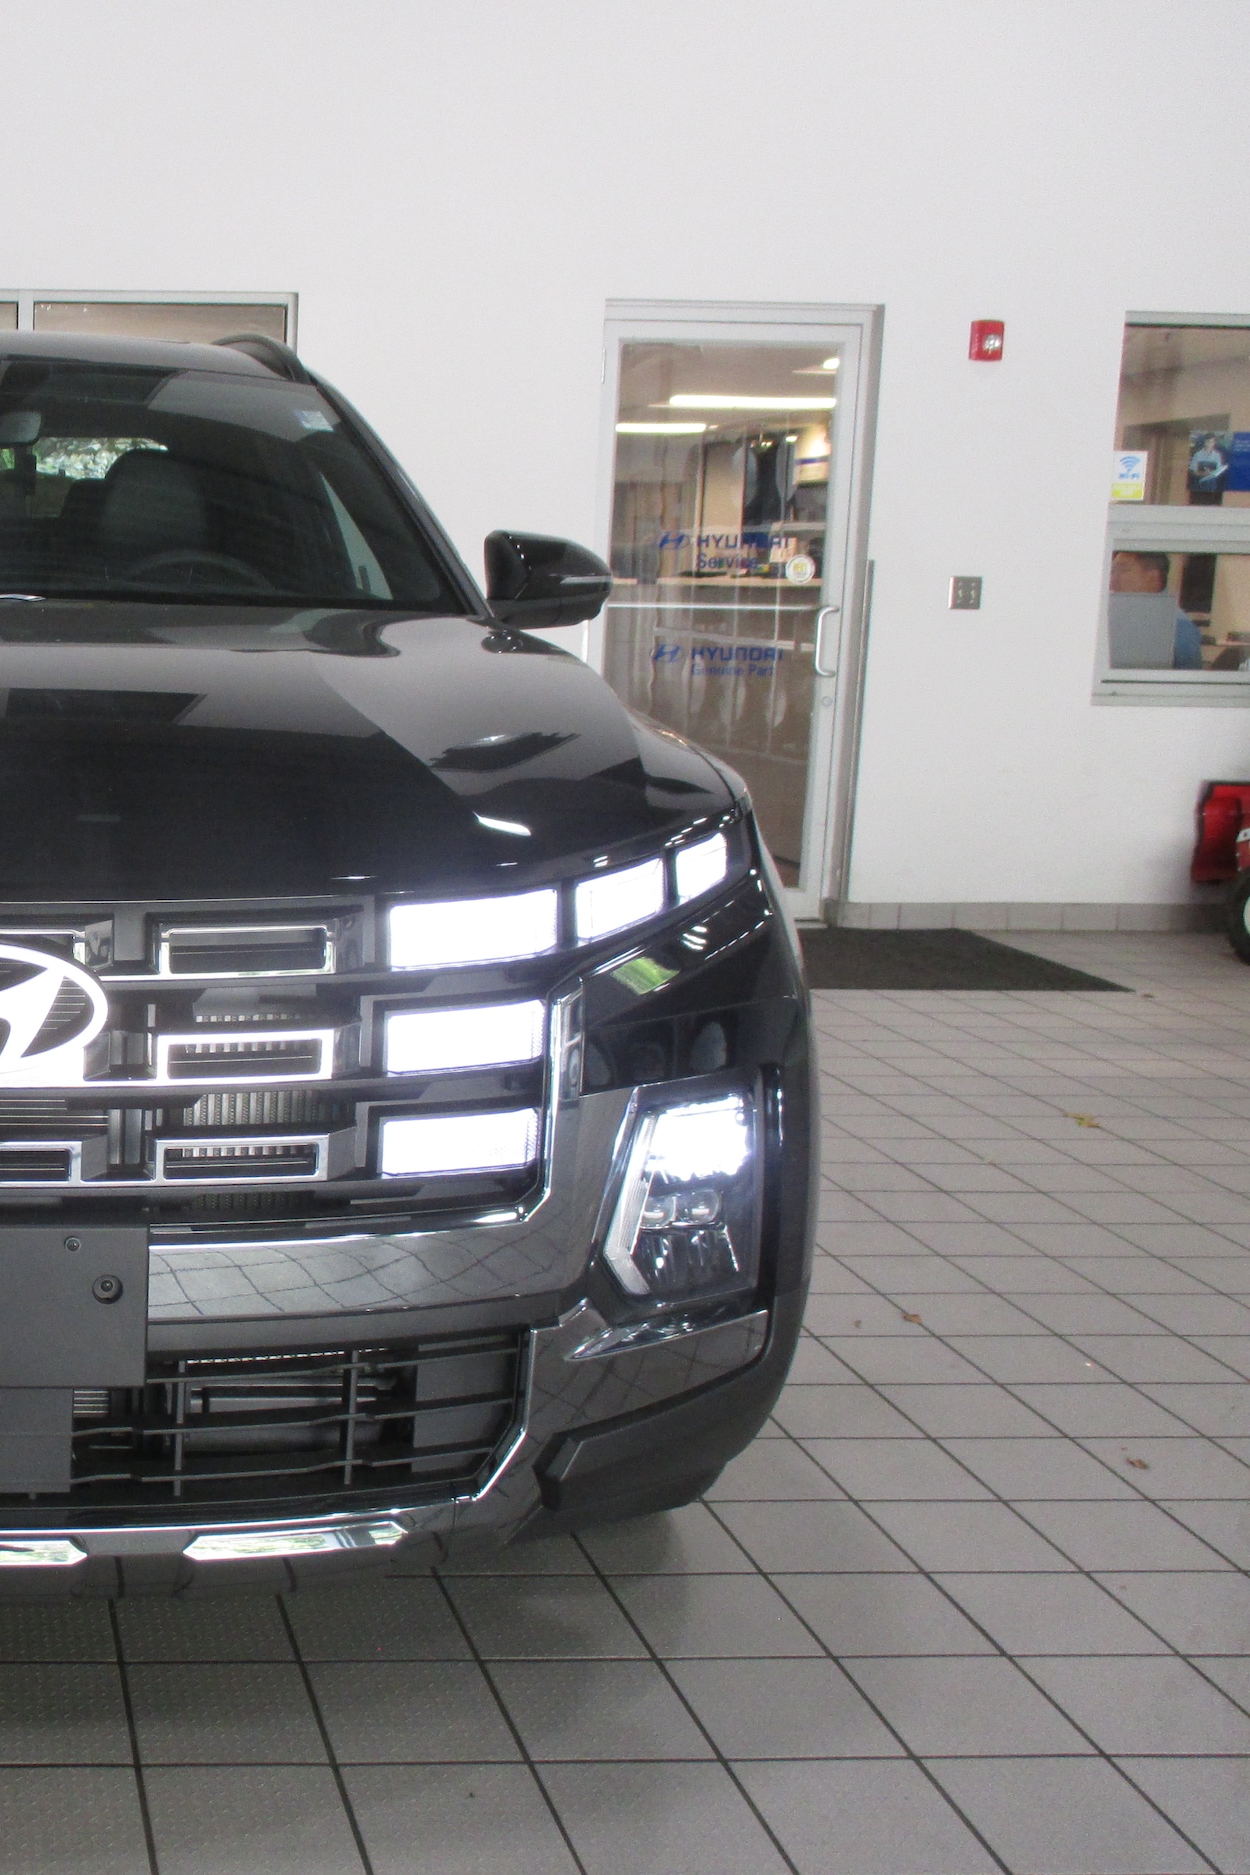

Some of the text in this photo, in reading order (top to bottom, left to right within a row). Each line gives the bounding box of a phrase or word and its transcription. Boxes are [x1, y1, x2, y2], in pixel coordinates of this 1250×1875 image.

[696, 533, 789, 549] HYUNDAI
[696, 553, 759, 569] Service
[692, 646, 783, 661] HYUNDAI
